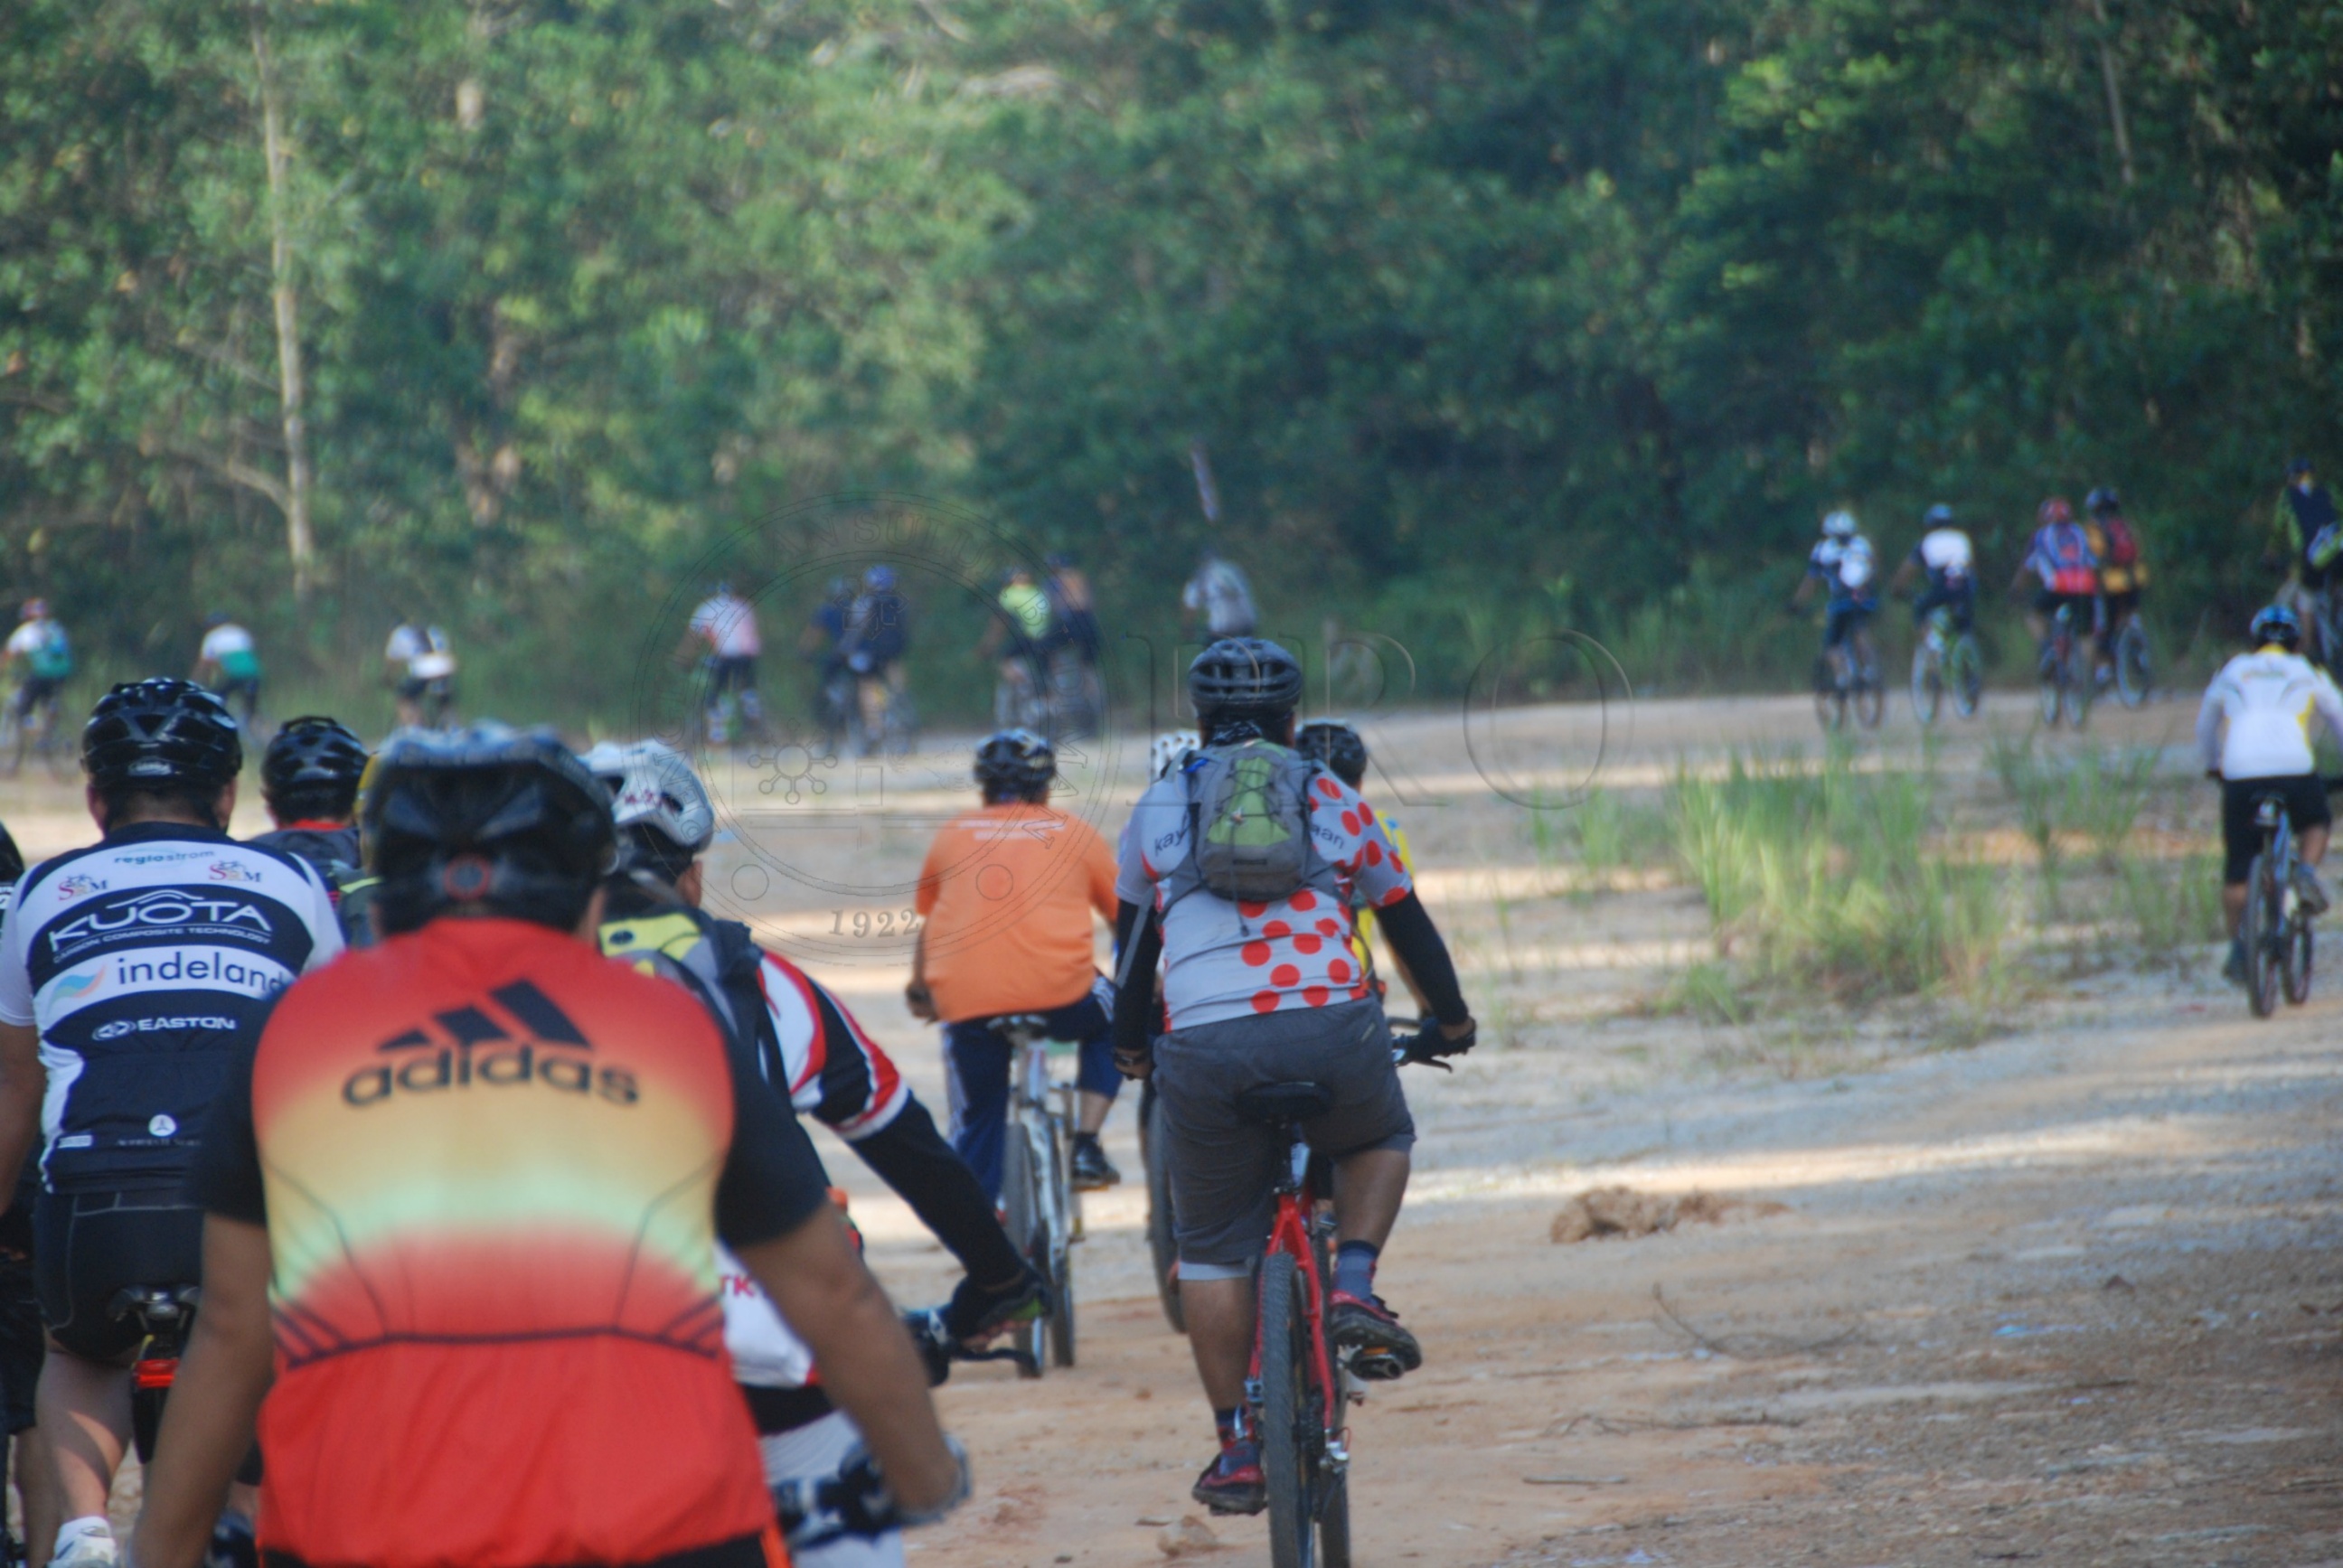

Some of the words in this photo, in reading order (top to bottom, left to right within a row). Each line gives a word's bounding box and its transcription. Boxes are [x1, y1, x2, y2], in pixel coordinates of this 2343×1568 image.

[114, 850, 215, 865] regiostrom
[48, 900, 273, 952] KUOTA
[102, 927, 183, 943] COMPOSITE
[137, 1017, 236, 1032] EASTON
[342, 1043, 639, 1108] adidas
